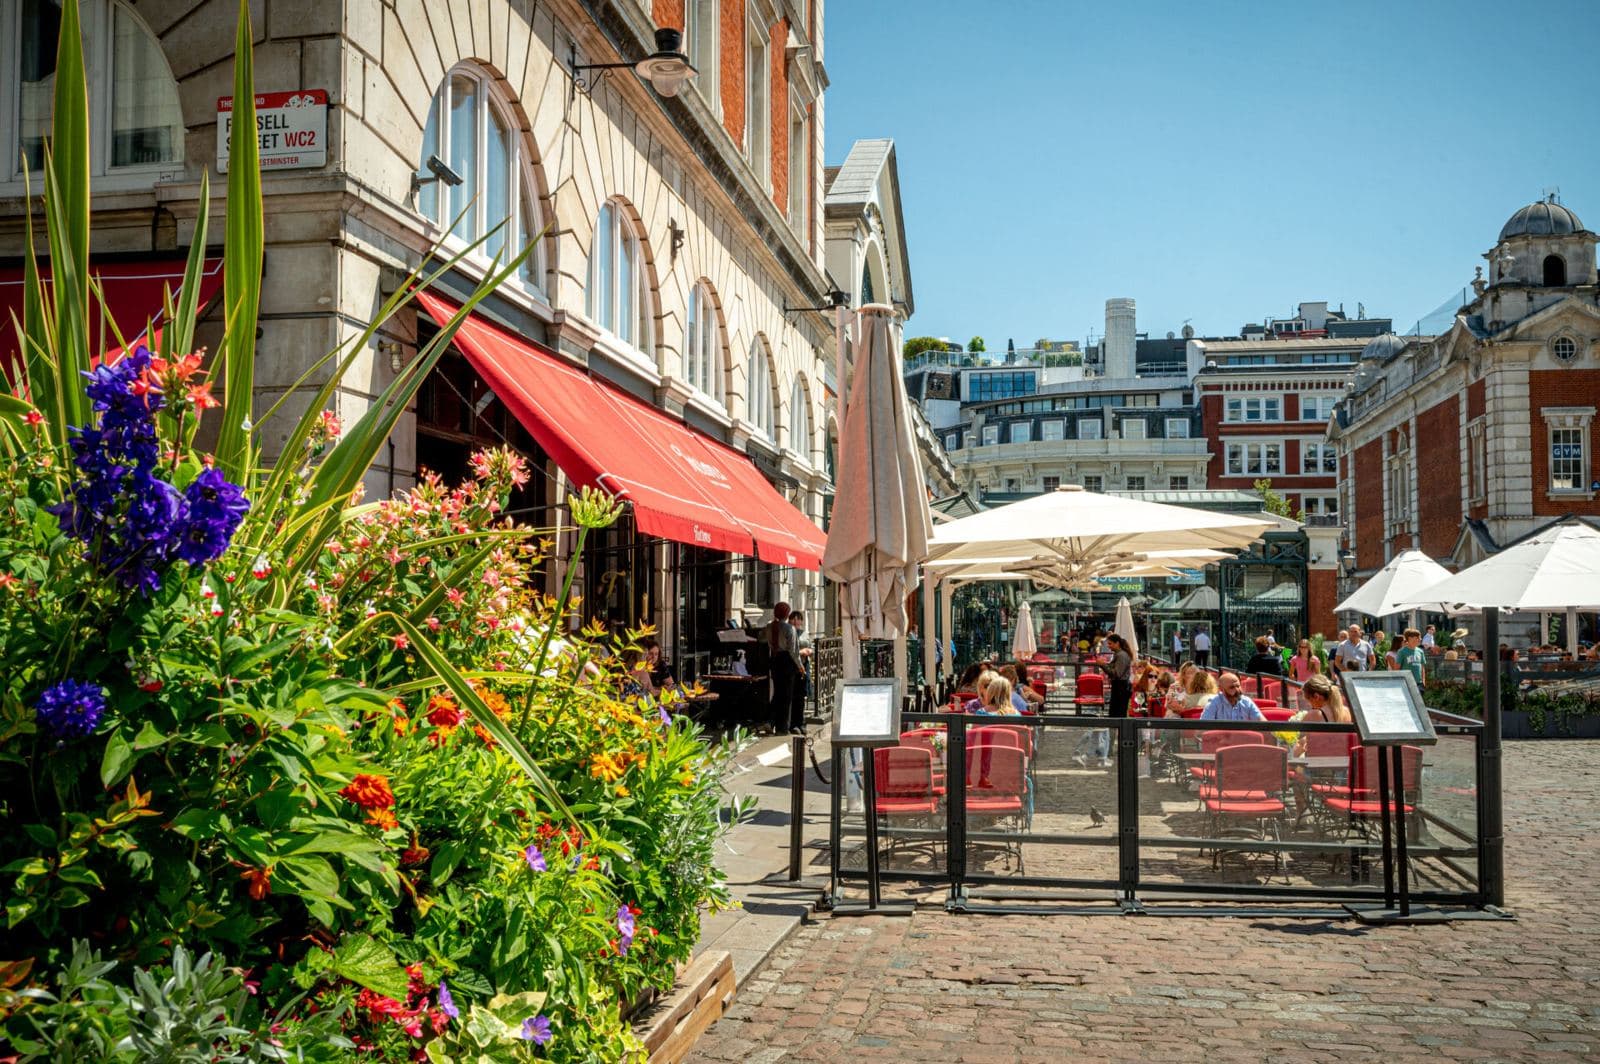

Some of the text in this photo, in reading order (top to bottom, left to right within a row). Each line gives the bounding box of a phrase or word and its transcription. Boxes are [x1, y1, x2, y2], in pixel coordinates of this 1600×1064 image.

[284, 131, 316, 148] WC2
[1553, 447, 1581, 456] GYM
[1117, 583, 1142, 591] EVENTS
[1549, 616, 1561, 643] GYM
